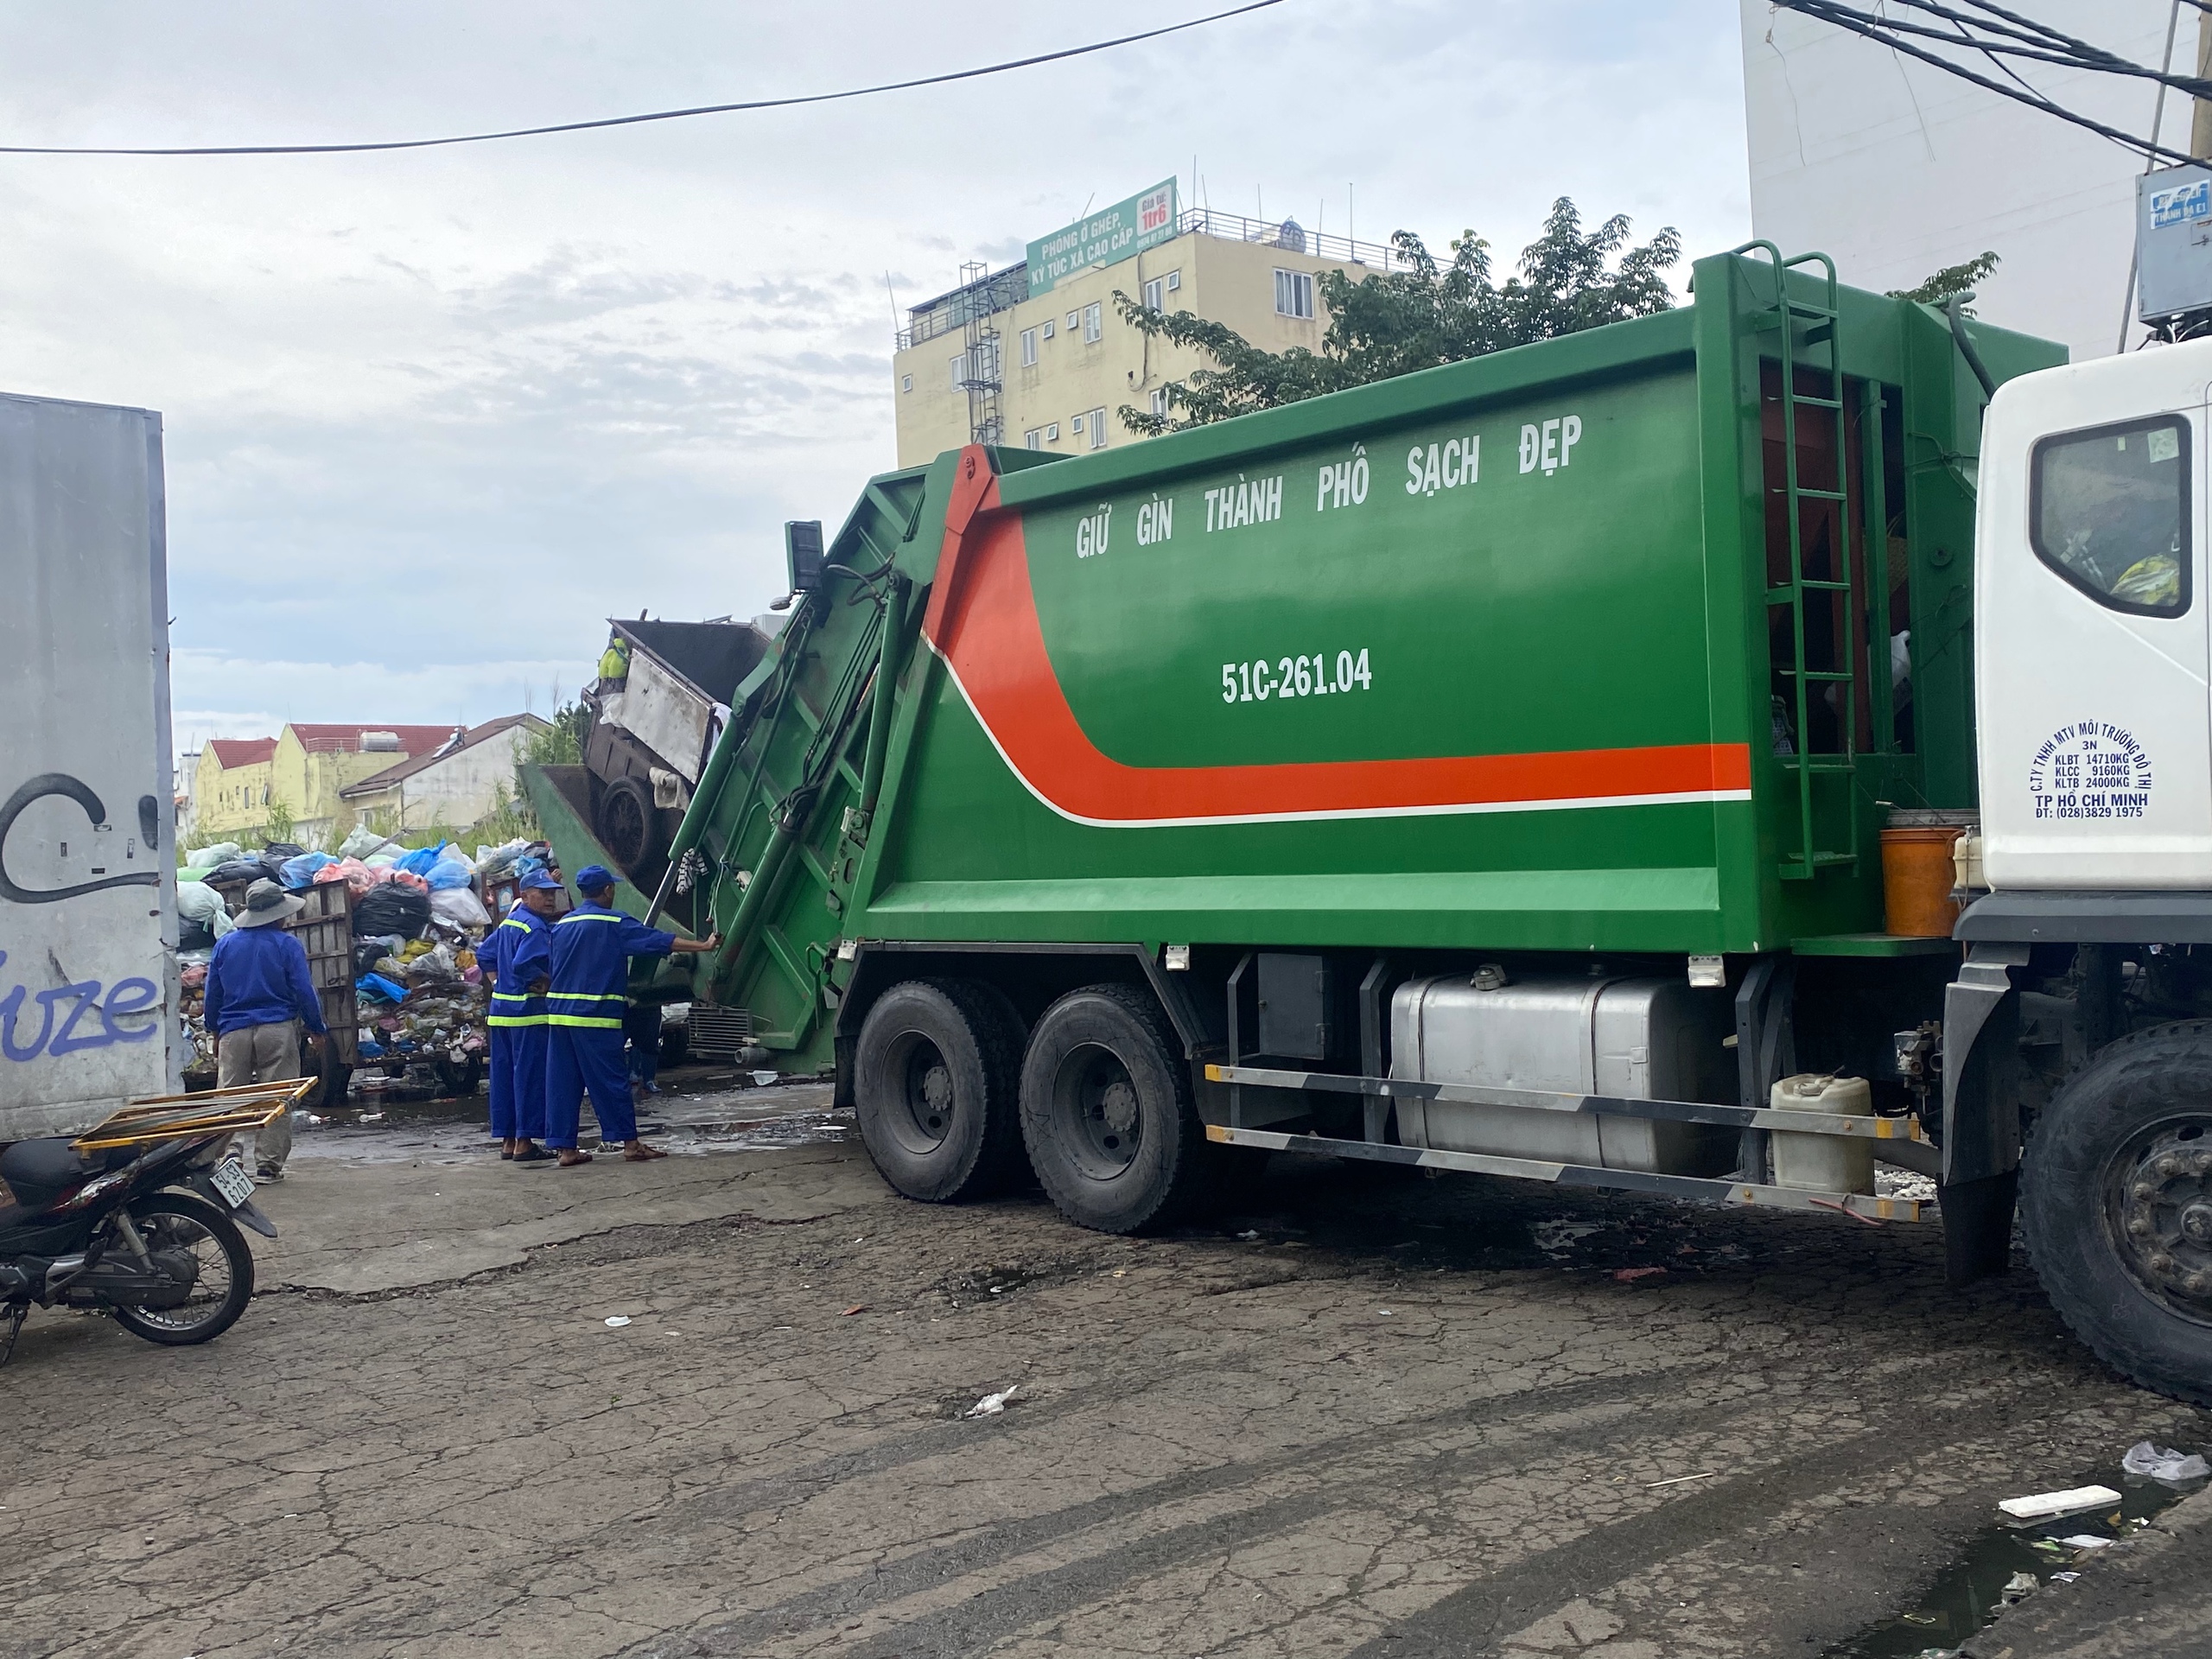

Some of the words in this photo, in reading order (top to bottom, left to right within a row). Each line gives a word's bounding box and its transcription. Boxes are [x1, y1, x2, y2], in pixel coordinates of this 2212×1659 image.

[1141, 203, 1166, 231] 1tr6
[1041, 232, 1078, 260] PHÒNG
[1080, 221, 1089, 242] Ở
[1090, 212, 1122, 238] GHÉP,
[1031, 264, 1045, 286] KÝ
[1047, 257, 1067, 279] TÚC
[1070, 246, 1084, 270] XÁ
[1087, 238, 1109, 262] CAO
[1111, 224, 1134, 251] CẤP
[1076, 501, 1112, 559] GIỮ
[1136, 493, 1173, 546] GÌN
[1204, 474, 1283, 532] THÀNH
[1317, 441, 1370, 512] PHỐ
[1405, 435, 1481, 498] SẠCH
[1518, 414, 1583, 477] ĐẸP
[1221, 648, 1372, 704] 51C-261.04
[2053, 725, 2075, 745] MTV
[2078, 719, 2099, 736] MÔI
[2082, 741, 2098, 750] 3N
[2101, 722, 2140, 755] TRƯỜNG
[2033, 740, 2057, 767] TNHH
[2055, 754, 2080, 766] KLBT
[2086, 753, 2130, 765] 14710KG
[2133, 753, 2152, 770] ĐÔ
[2055, 766, 2080, 777] KLCC
[2092, 765, 2130, 776] 9160KG
[2055, 778, 2080, 789] KLTB
[2086, 777, 2130, 788] 24000KG
[2134, 772, 2152, 790] THỊ
[2035, 795, 2053, 808] TP
[2057, 789, 2077, 807] HỒ
[2082, 790, 2107, 807] CHÍ
[2110, 792, 2148, 806] MINH
[2036, 807, 2053, 818] ĐT:
[2056, 807, 2112, 819] (028)3829
[2115, 806, 2143, 817] 1975
[227, 1178, 251, 1204] 6207
